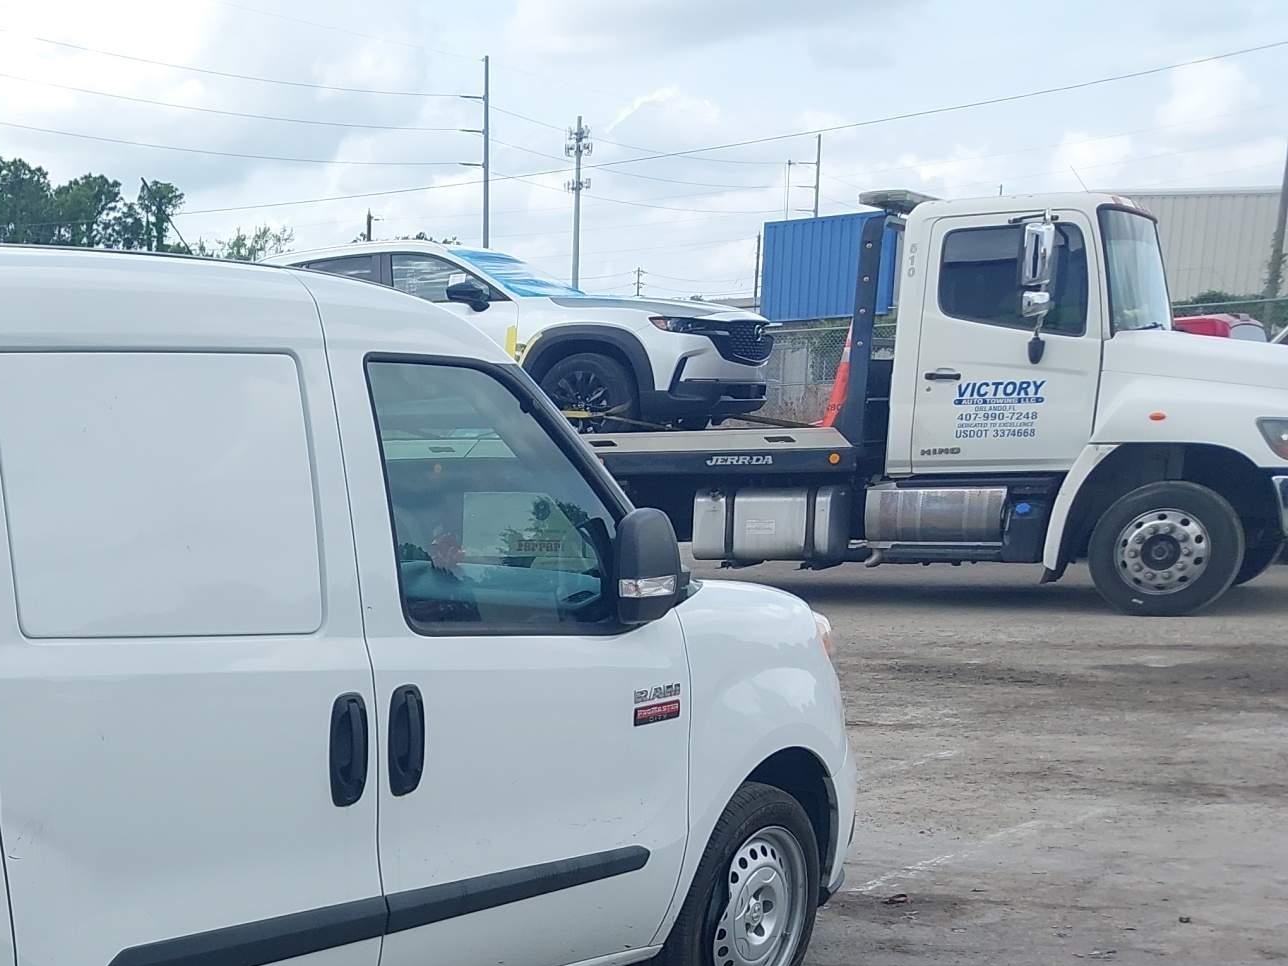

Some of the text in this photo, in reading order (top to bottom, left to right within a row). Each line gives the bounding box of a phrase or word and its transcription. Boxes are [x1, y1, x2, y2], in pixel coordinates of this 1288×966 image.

[957, 381, 1046, 397] VICTORY
[985, 397, 1018, 405] TOWING
[957, 411, 1038, 421] 407-990-7248
[955, 428, 1036, 439] USDOT 3374668
[634, 683, 680, 704] RAM
